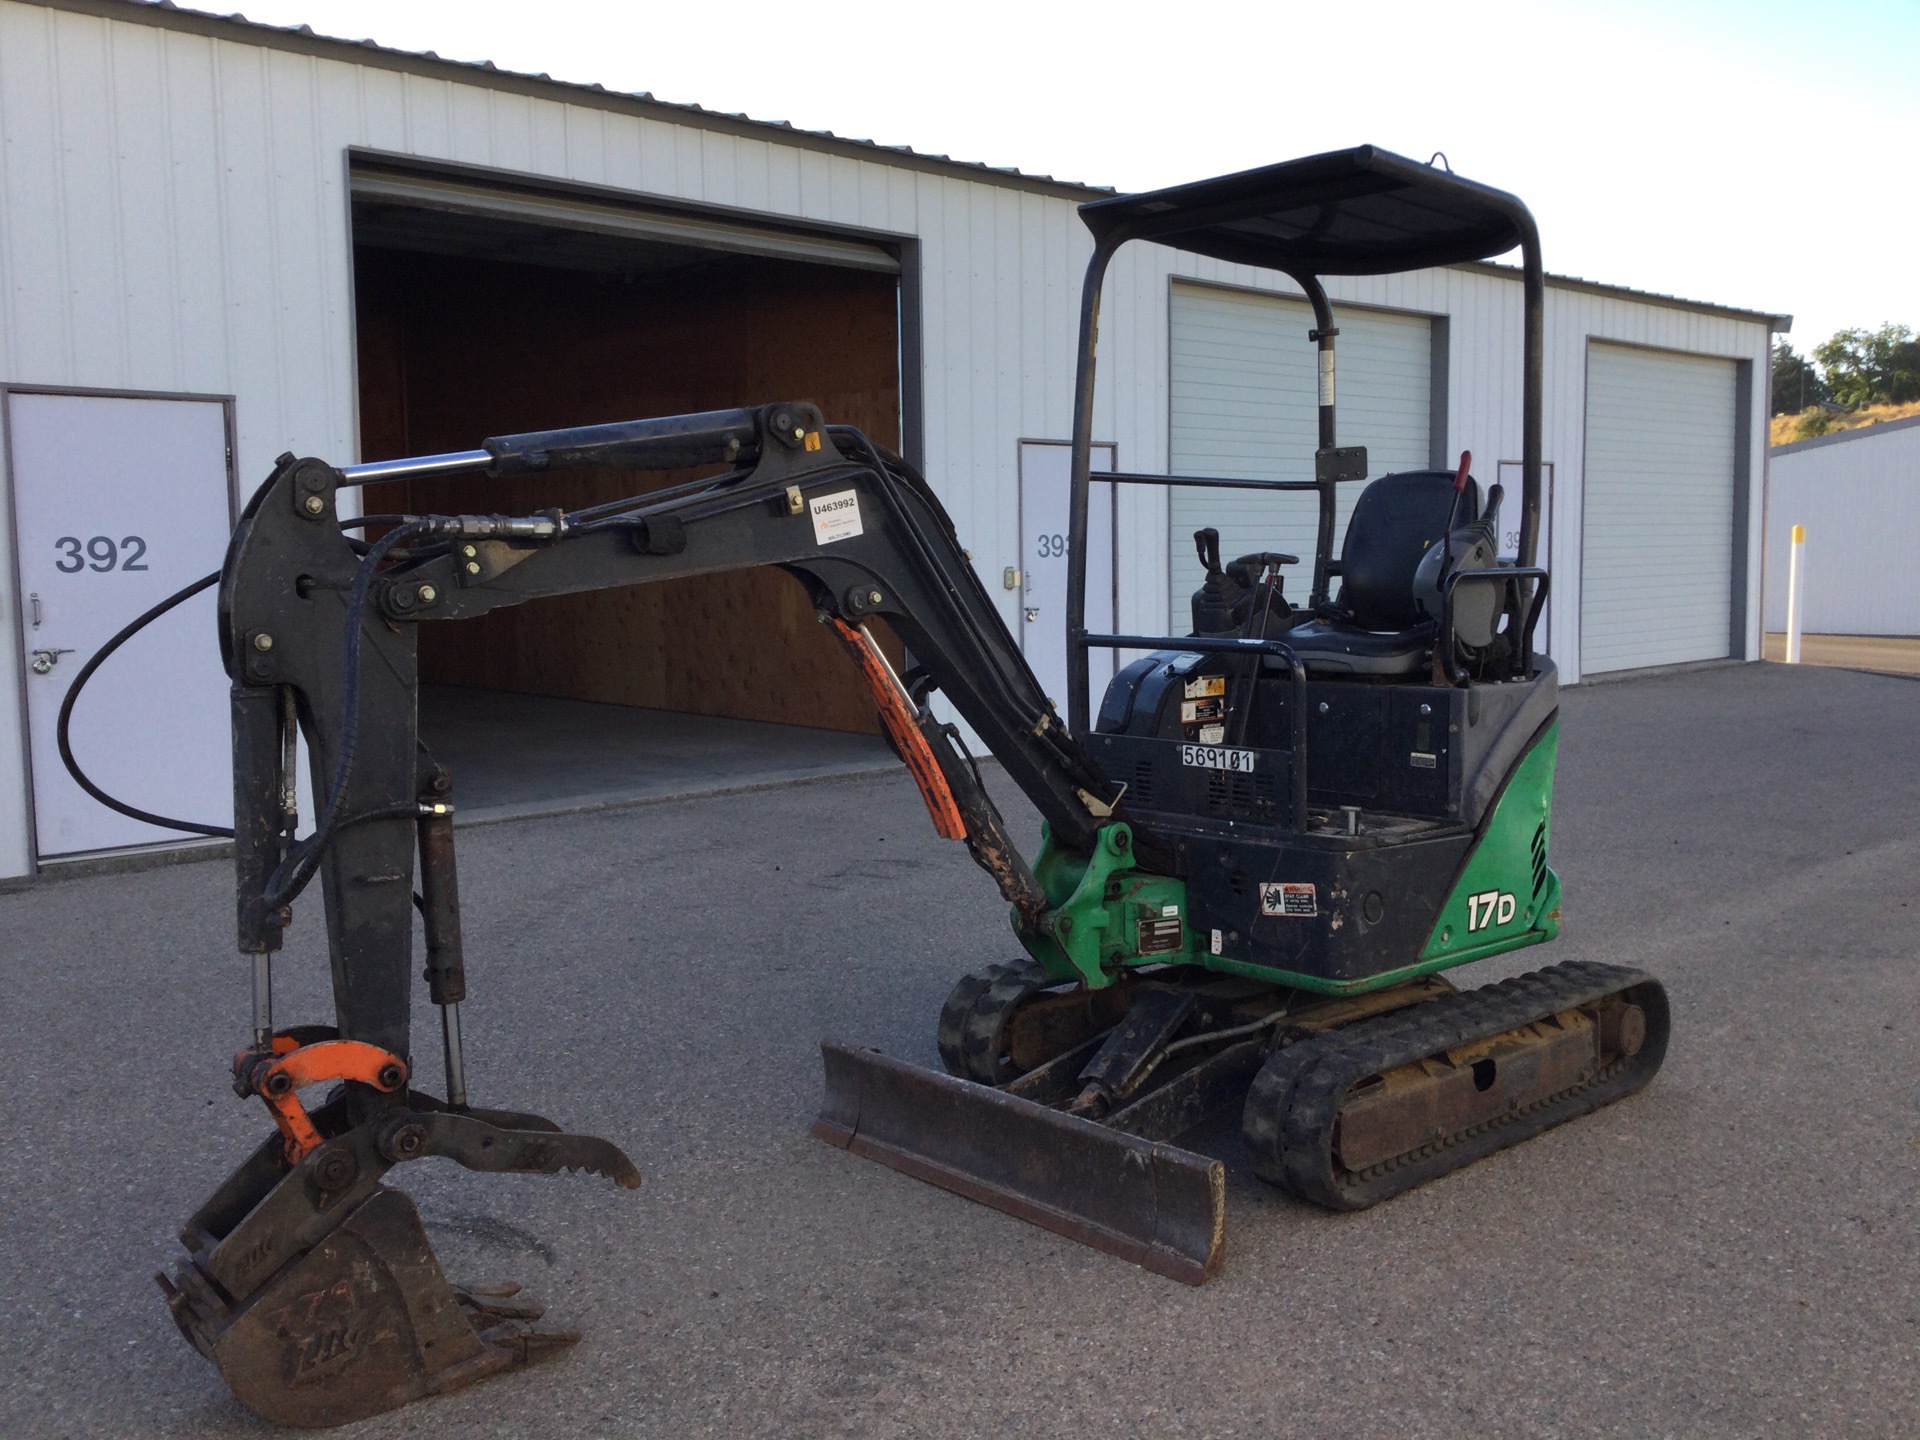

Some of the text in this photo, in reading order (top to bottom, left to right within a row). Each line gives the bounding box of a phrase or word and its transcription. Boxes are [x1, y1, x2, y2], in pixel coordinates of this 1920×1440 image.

[813, 497, 855, 515] U463992
[1037, 533, 1070, 558] 39
[1505, 531, 1521, 549] 39
[55, 535, 148, 573] 392
[1184, 746, 1250, 772] 569101
[1467, 889, 1516, 933] 17D
